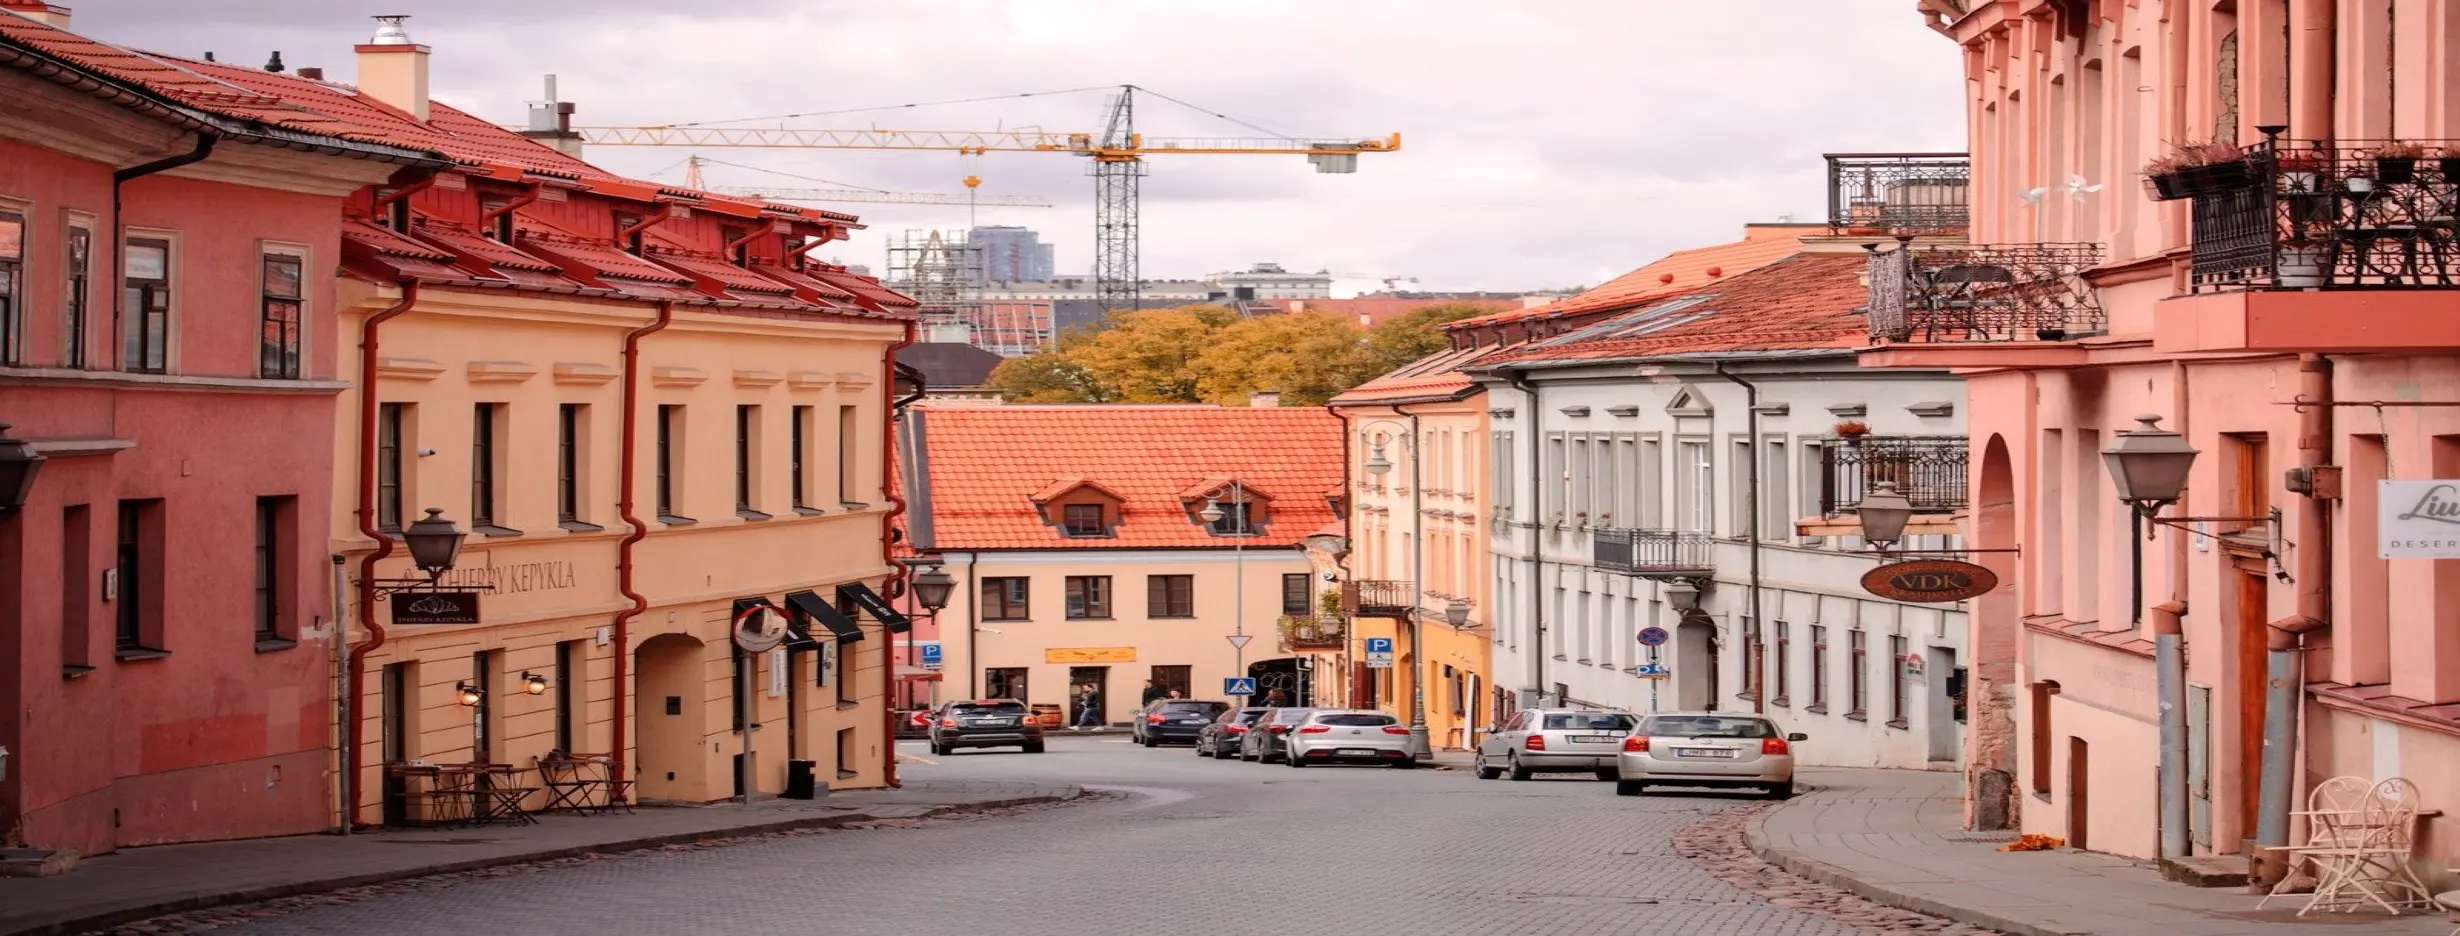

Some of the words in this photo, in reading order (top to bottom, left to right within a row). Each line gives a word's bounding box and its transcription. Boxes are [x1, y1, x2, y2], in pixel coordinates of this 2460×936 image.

[2391, 540, 2457, 548] DESER
[437, 565, 506, 595] THIERRY
[510, 561, 576, 593] KEPYKLA
[1899, 574, 1966, 589] VDK
[926, 646, 937, 655] P
[1373, 639, 1389, 651] P
